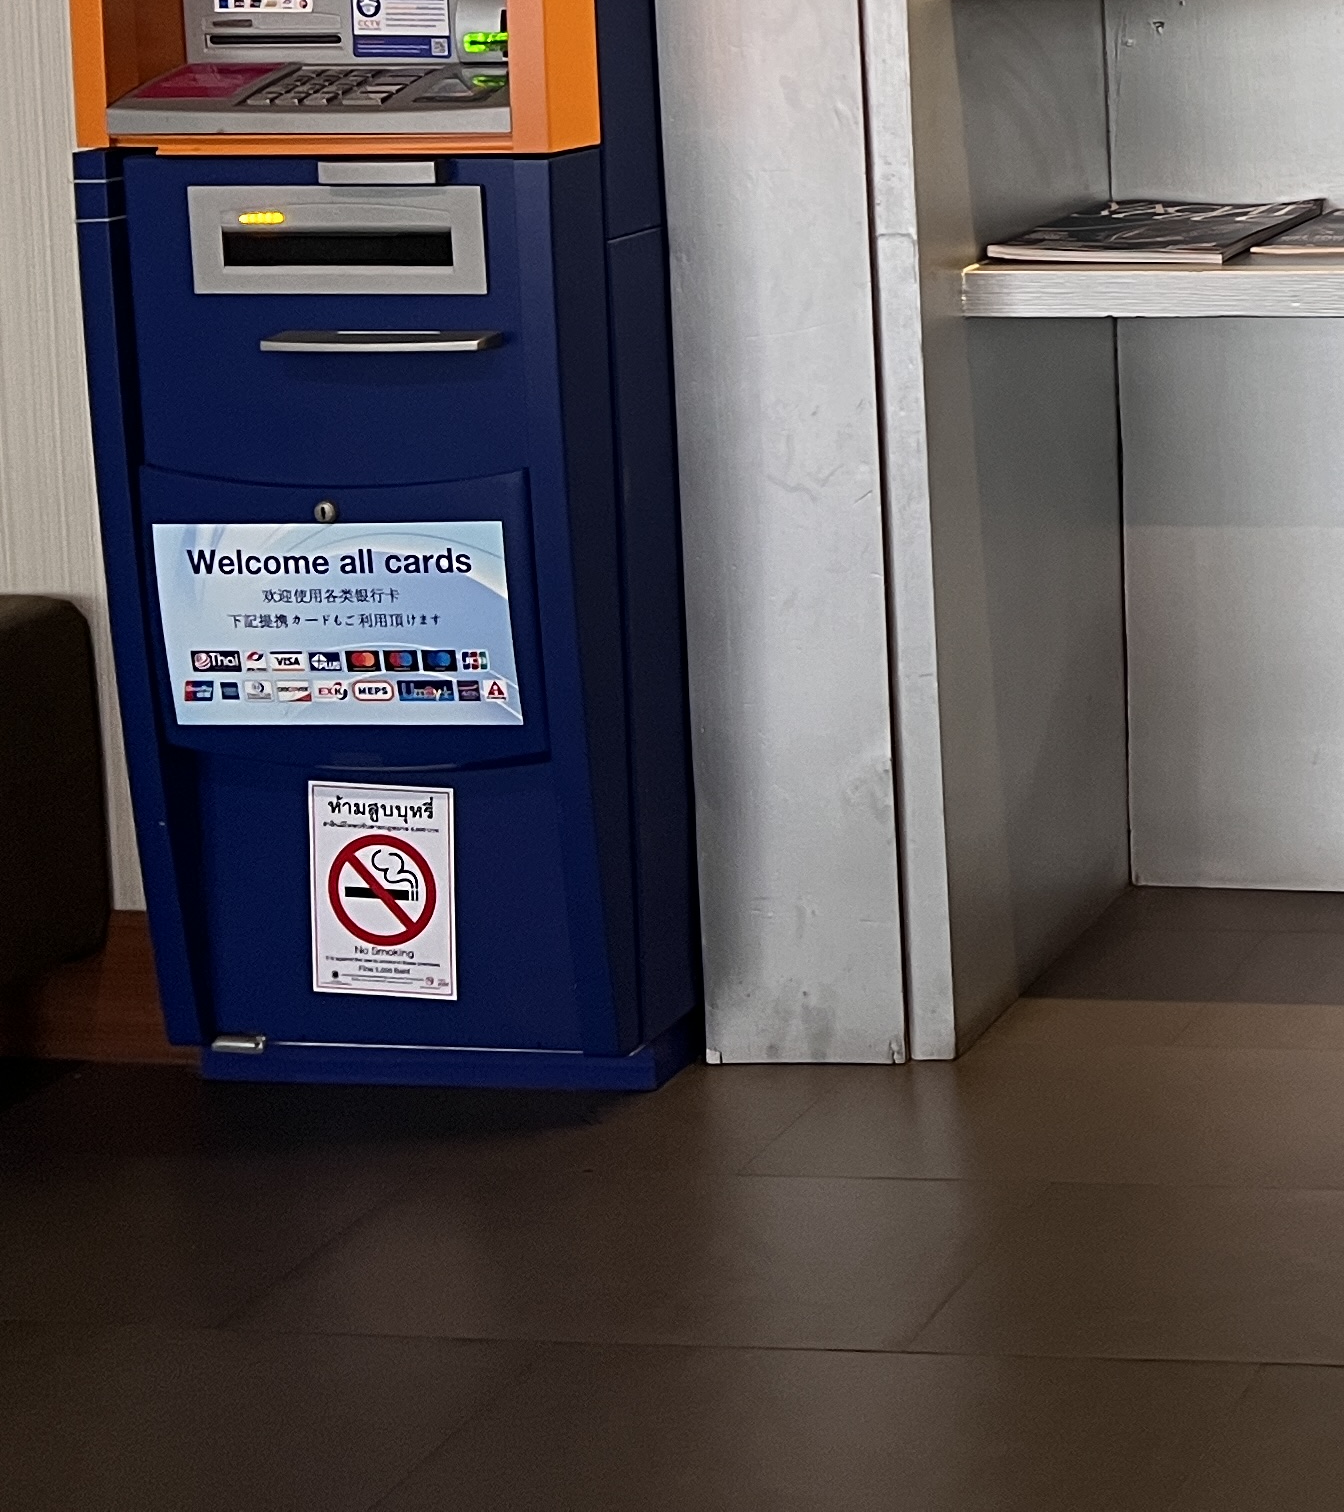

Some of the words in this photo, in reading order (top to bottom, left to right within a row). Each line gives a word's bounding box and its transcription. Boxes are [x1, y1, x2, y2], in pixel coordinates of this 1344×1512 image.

[186, 548, 330, 576] Welcome
[339, 547, 375, 575] all
[384, 547, 473, 575] cards
[261, 587, 401, 604] 欢迎使用各类银行卡
[274, 656, 301, 667] VISA
[319, 660, 341, 670] PLUS
[358, 686, 389, 696] MEPS
[327, 794, 434, 825] ห้ามสูบบุหรี่
[354, 945, 369, 955] No
[371, 946, 415, 960] Smoking
